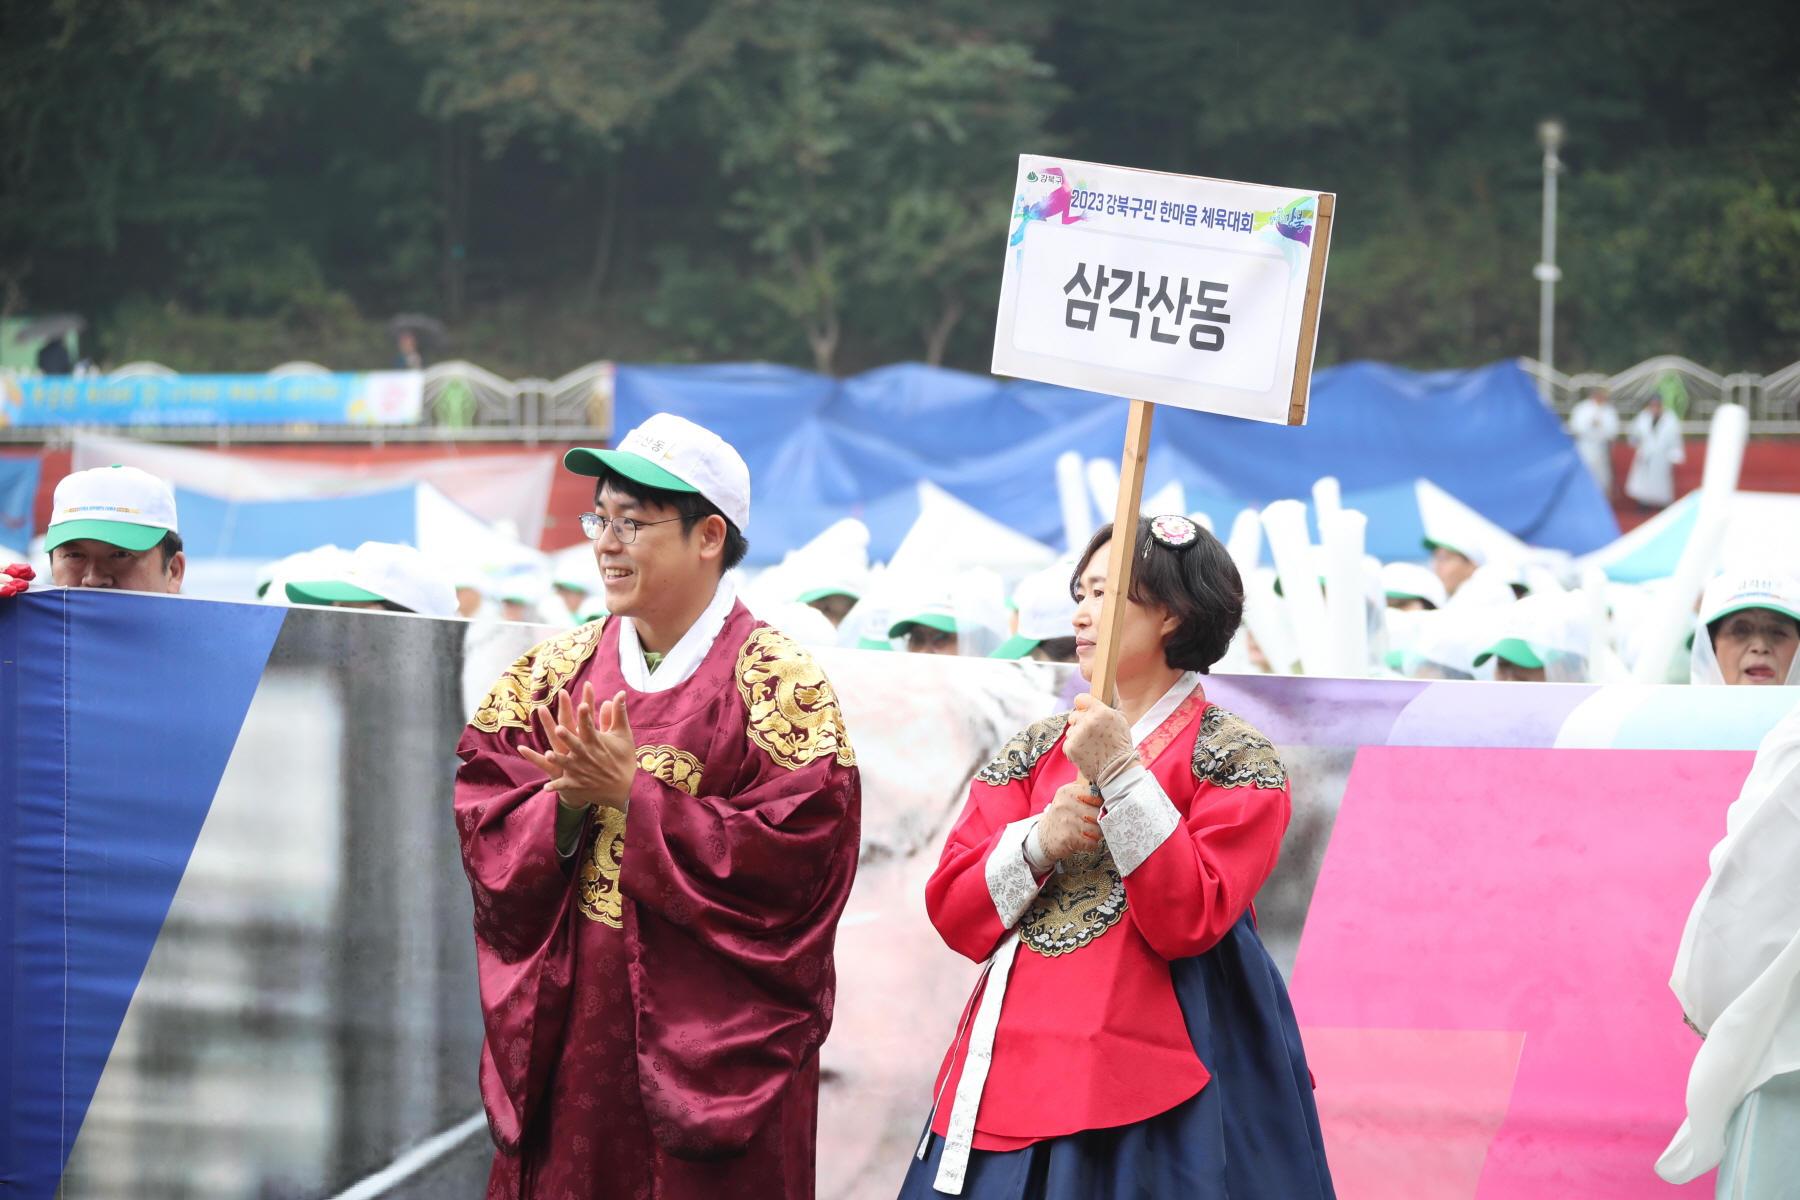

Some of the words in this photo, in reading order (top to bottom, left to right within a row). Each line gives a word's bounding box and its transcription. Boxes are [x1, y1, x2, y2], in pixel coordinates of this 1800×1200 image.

[1040, 174, 1062, 184] 강북구
[1070, 190, 1104, 212] 2023
[1106, 195, 1156, 221] 강북구민
[1159, 202, 1198, 227] 한마음
[1201, 206, 1254, 234] 체육대회
[1286, 207, 1305, 233] 강북
[1063, 262, 1231, 352] 삼각산동
